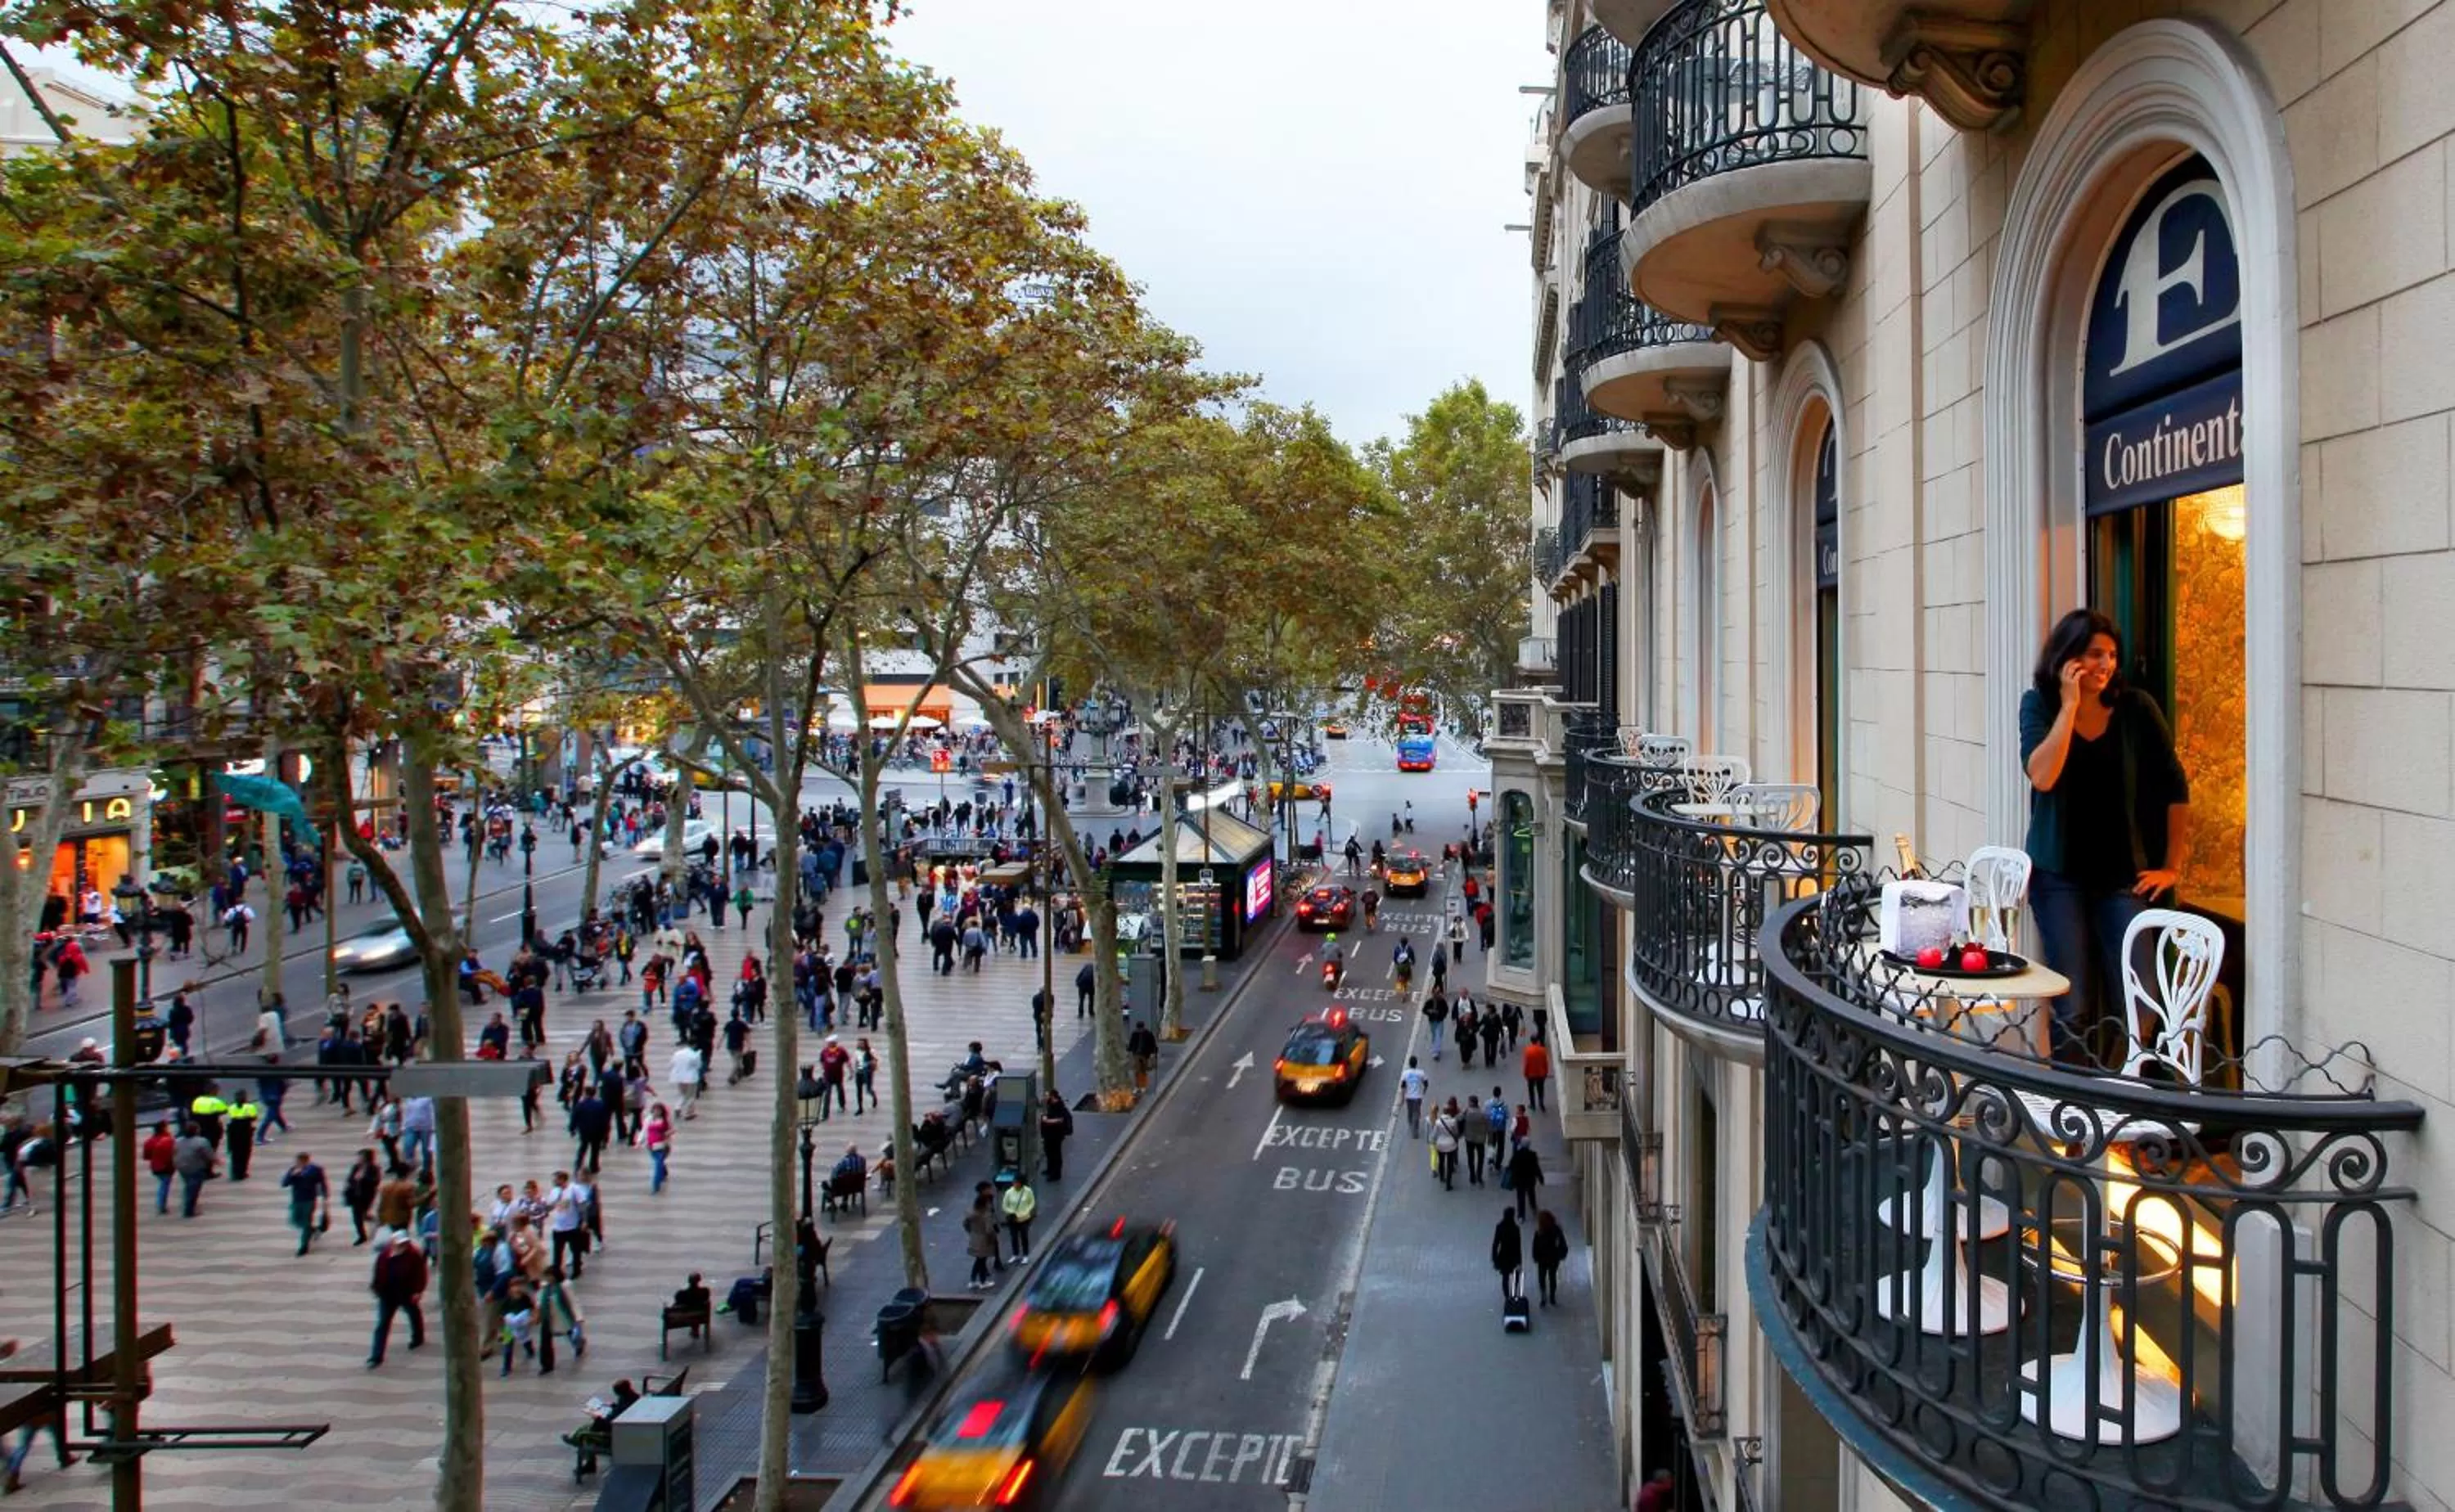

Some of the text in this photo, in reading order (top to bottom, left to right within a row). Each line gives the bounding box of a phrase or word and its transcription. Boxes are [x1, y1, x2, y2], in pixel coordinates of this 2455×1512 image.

[2103, 396, 2245, 491] Continent
[1384, 923, 1431, 934] BUS
[1333, 988, 1424, 1002] EXCEPE
[1348, 1007, 1403, 1022] BUS
[1264, 1125, 1389, 1151] EXCEPTE
[1273, 1166, 1368, 1193] BUS
